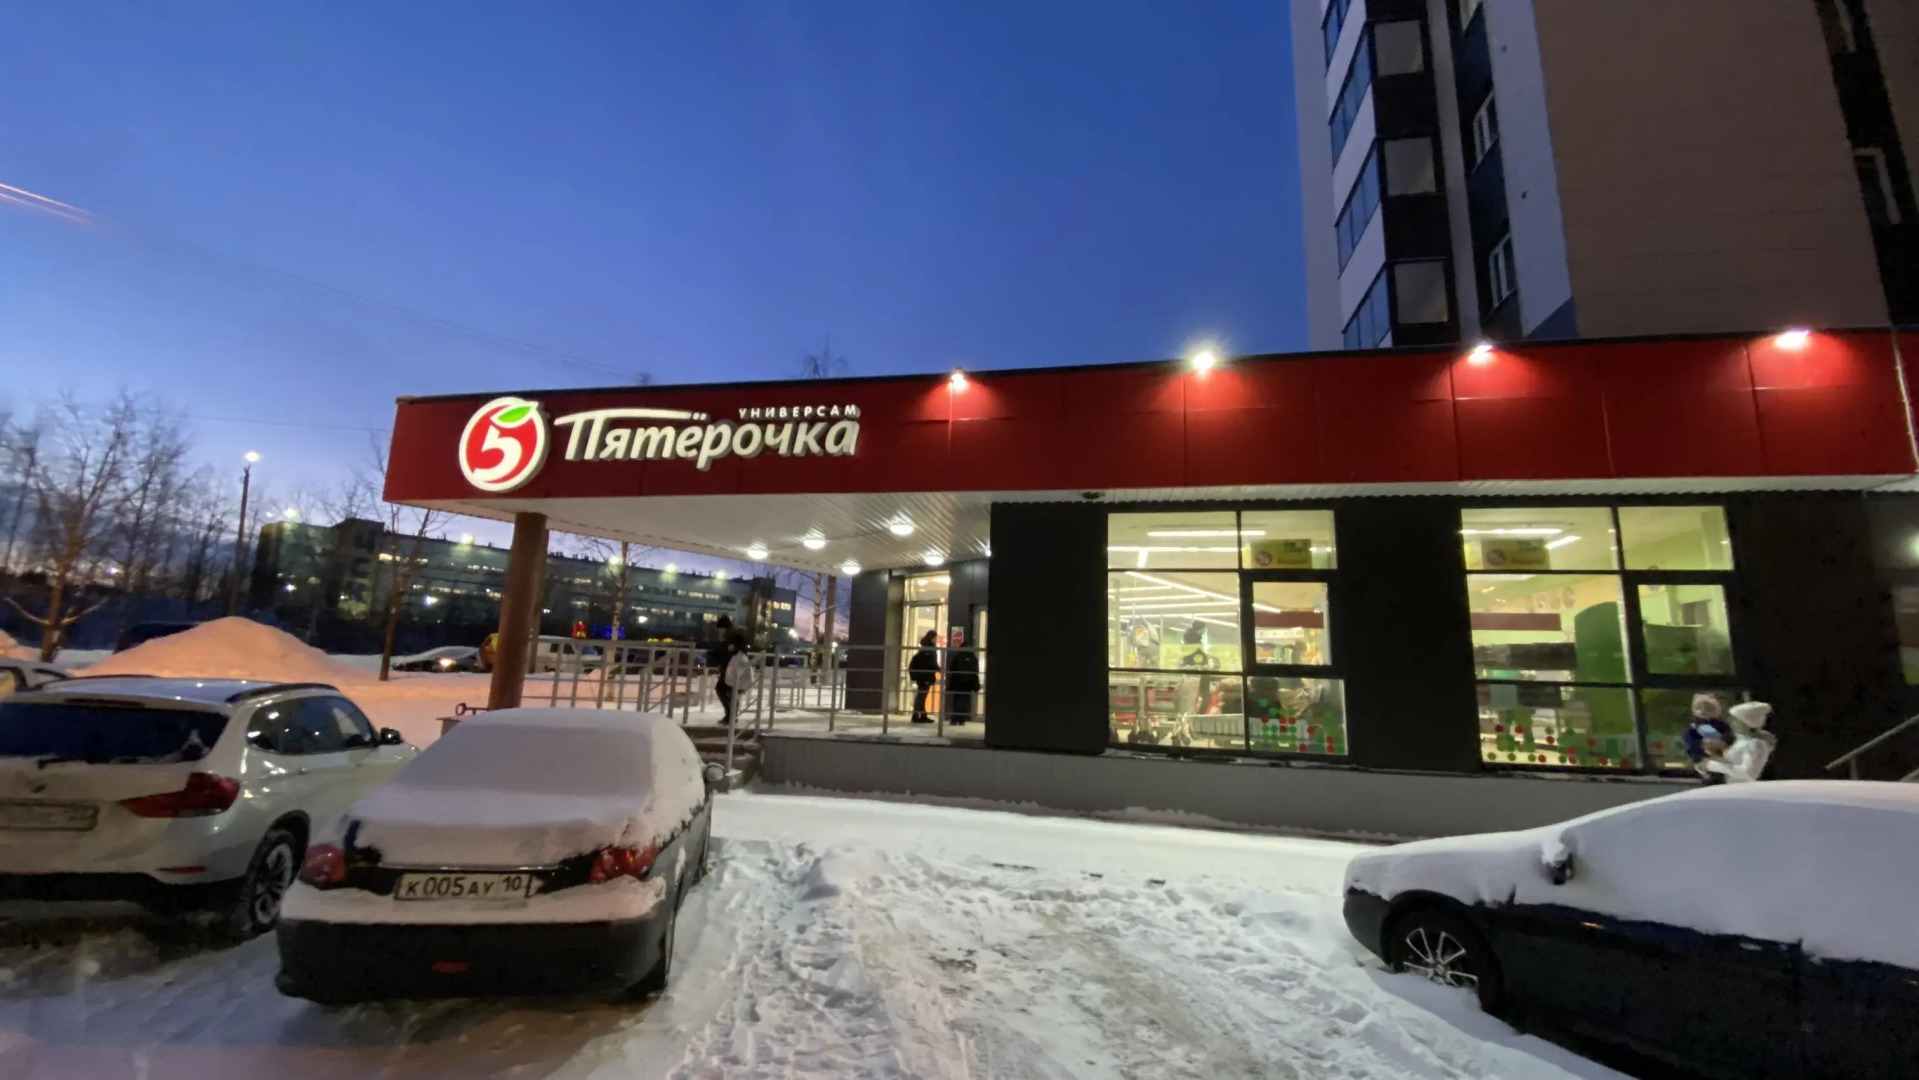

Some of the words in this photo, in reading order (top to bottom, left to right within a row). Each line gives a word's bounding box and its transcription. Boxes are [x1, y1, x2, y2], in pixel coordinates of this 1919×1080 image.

[738, 404, 858, 419] УНИВЕРСАМ
[471, 424, 523, 483] 5
[553, 407, 860, 470] Пятёрочка
[502, 876, 522, 892] 10
